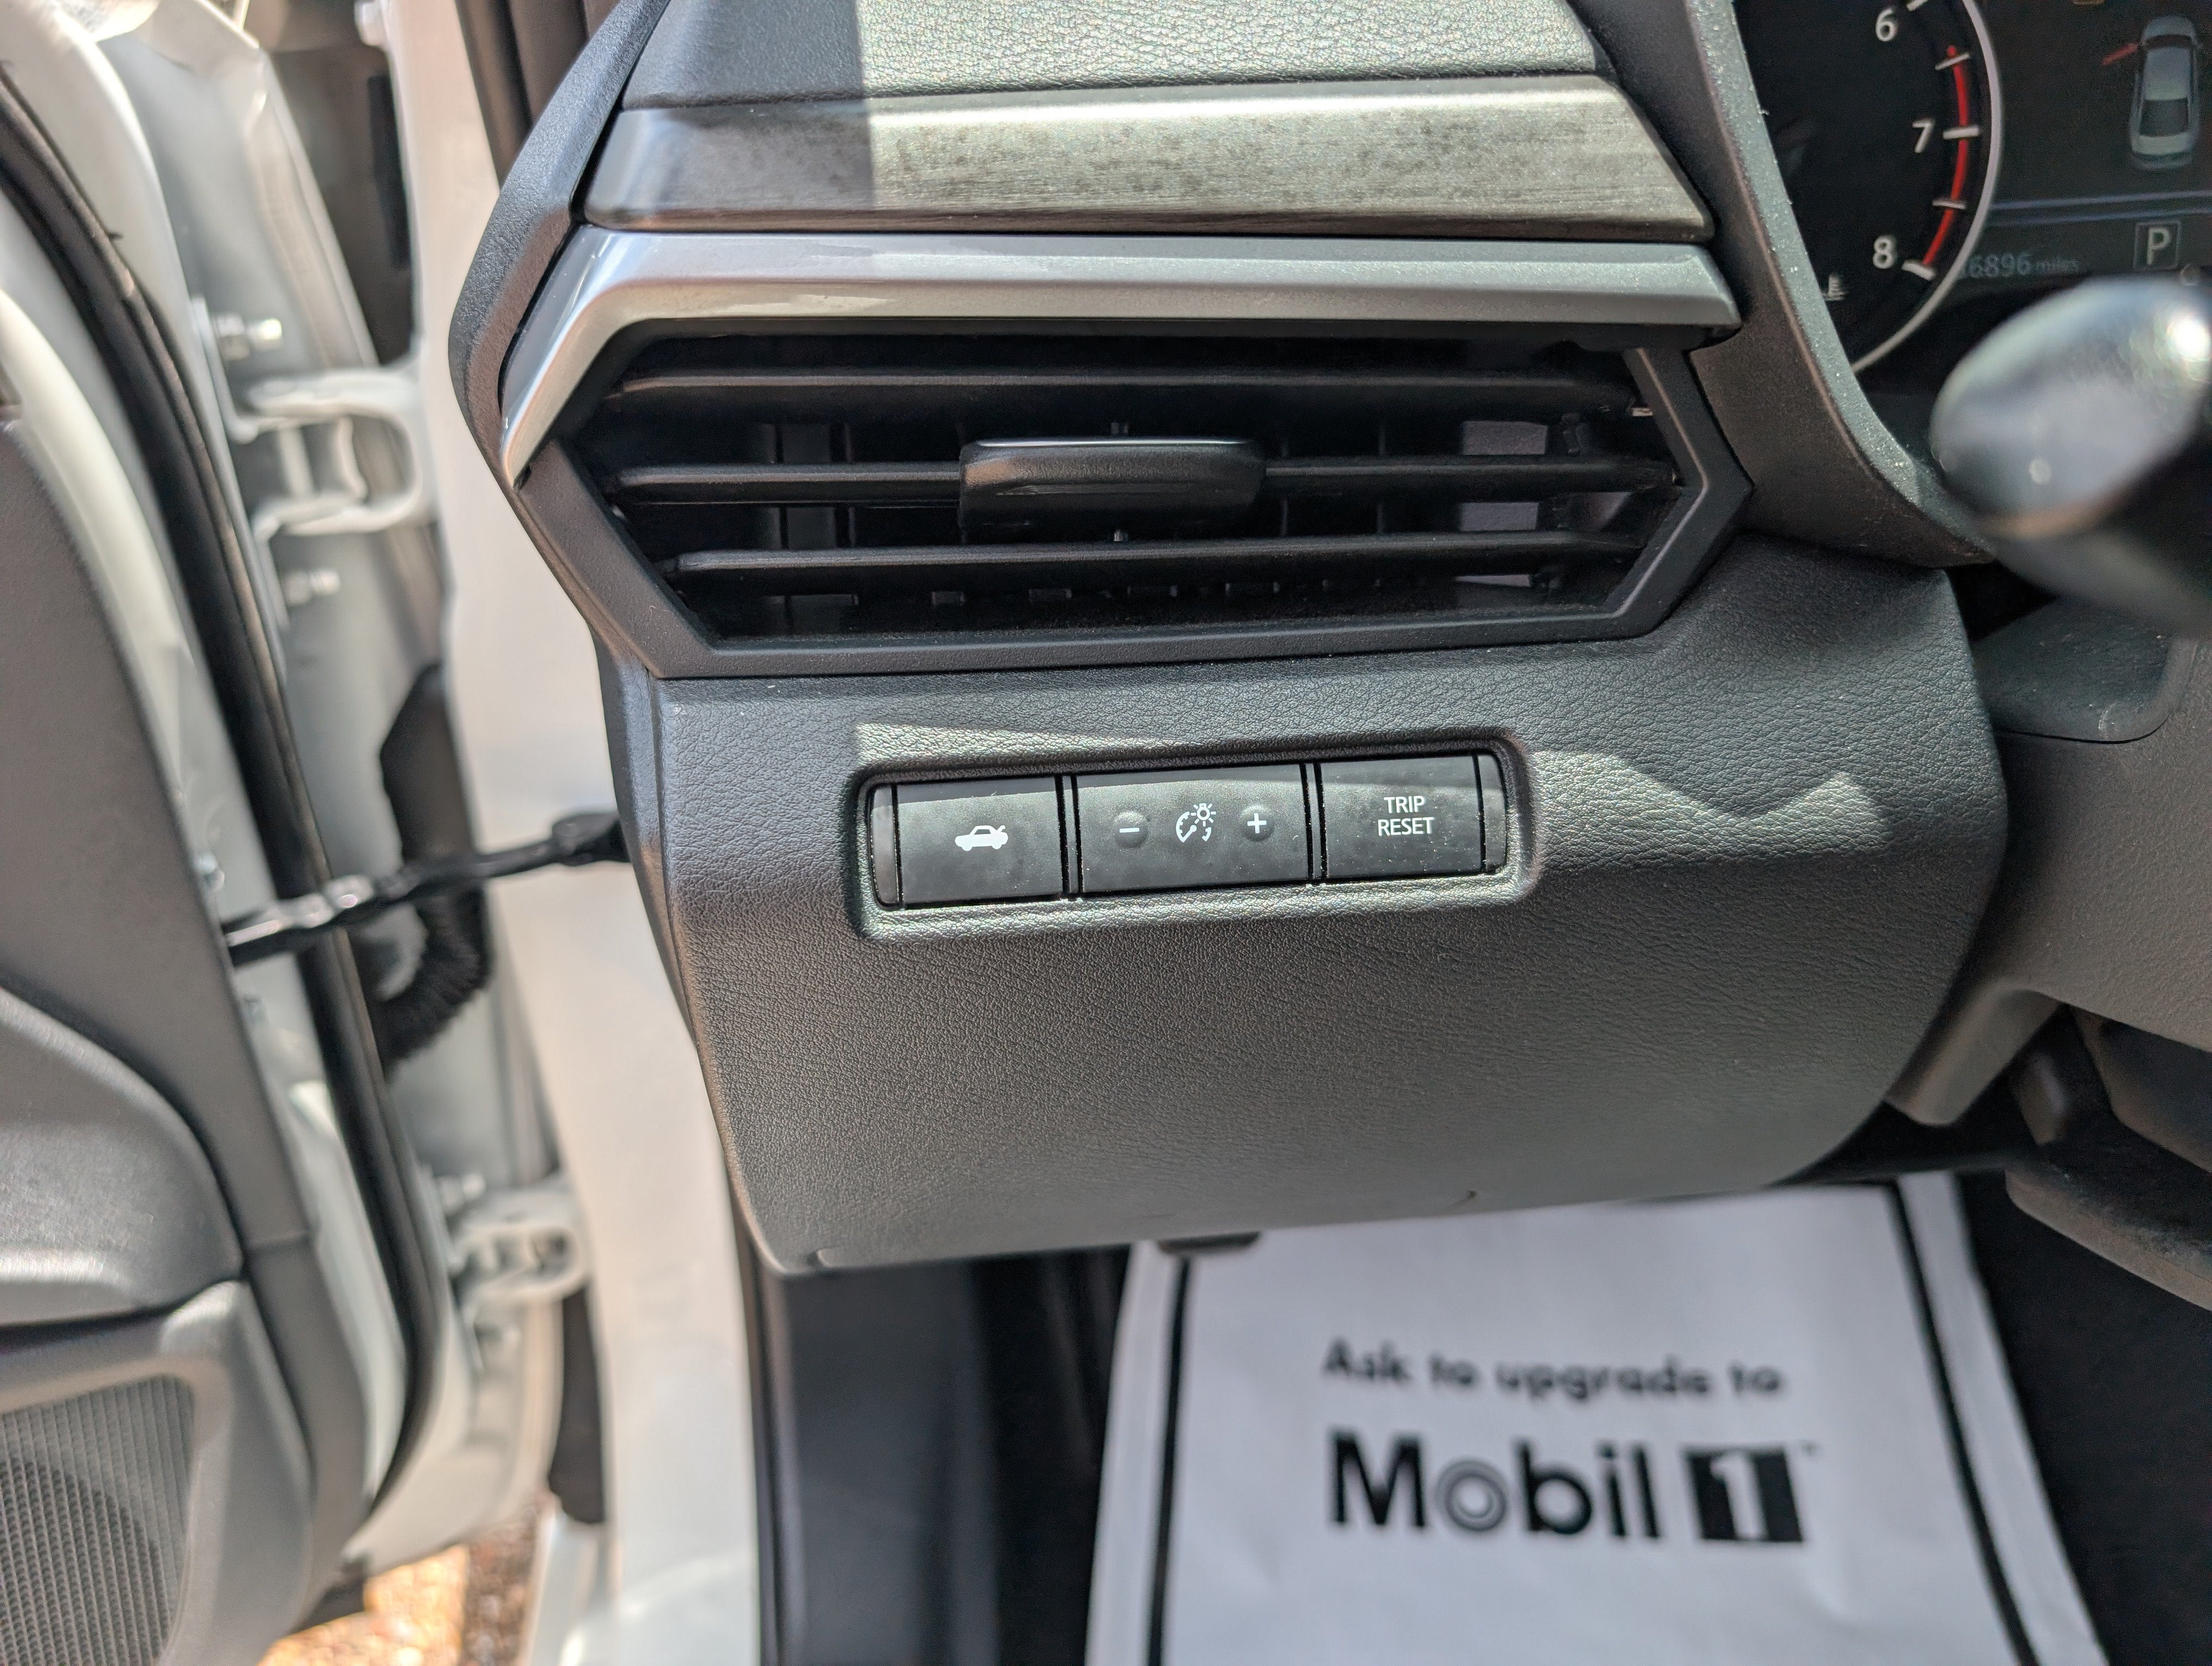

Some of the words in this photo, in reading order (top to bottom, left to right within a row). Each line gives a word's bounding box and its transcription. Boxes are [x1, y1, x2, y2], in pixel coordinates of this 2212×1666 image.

[1875, 8, 1896, 42] 6
[1912, 118, 1935, 153] 7
[1873, 235, 1895, 269] 8
[2147, 227, 2171, 265] P
[1384, 796, 1425, 813] TRIP
[1378, 817, 1435, 836] RESET
[1322, 1336, 1412, 1381] Ask
[1427, 1351, 1478, 1386] to
[1494, 1355, 1711, 1404] upgrade
[1729, 1360, 1783, 1396] to
[1329, 1427, 1662, 1539] Mobil
